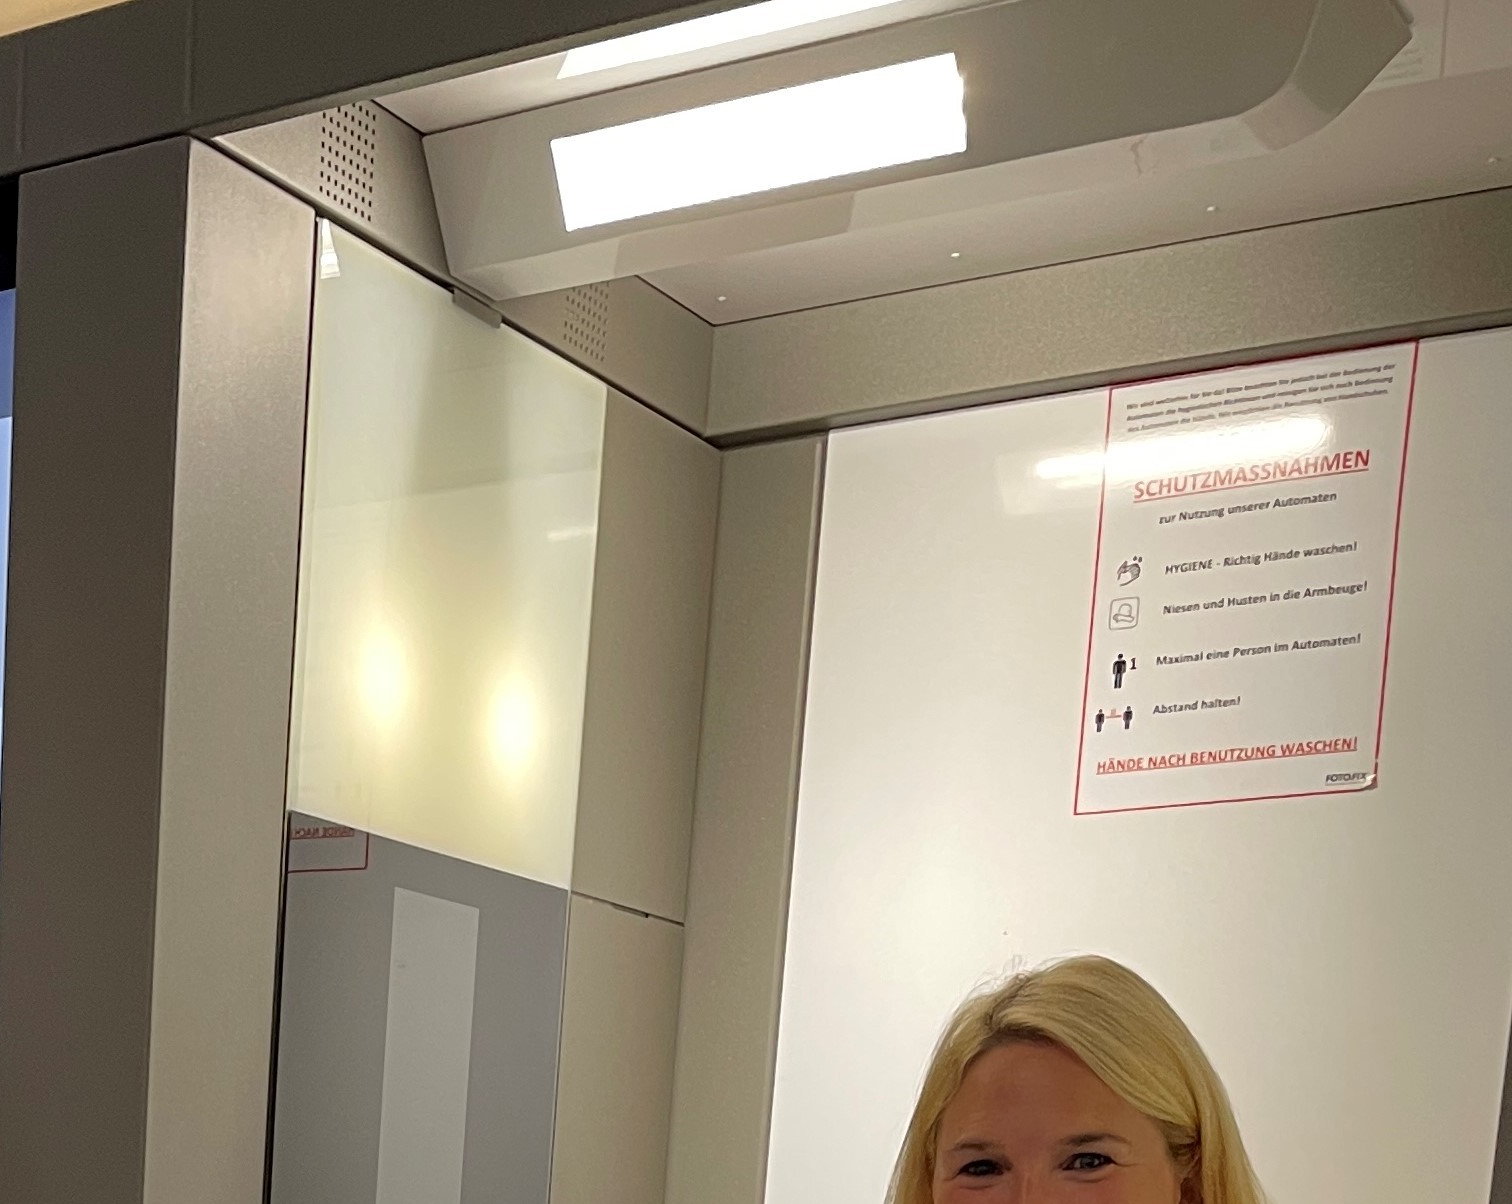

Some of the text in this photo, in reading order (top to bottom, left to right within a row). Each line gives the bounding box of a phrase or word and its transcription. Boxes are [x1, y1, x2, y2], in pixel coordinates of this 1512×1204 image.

[1134, 449, 1371, 501] SCHUTZMASSNAHMEN
[1159, 491, 1338, 525] zur Nutzung unserer Automaten
[1164, 559, 1213, 576] HYGIENE
[1223, 553, 1261, 569] Richtig
[1264, 548, 1300, 563] Hände
[1303, 541, 1358, 558] waschen!
[1163, 580, 1368, 615] Niesen und Husten in die Armbeuge!
[1156, 633, 1361, 667] Maximal eine Person im Automaten!
[1152, 696, 1241, 715] Abstand halten!
[1096, 736, 1358, 774] HÄNDE NACH BENUTZUNG WASCHEN!
